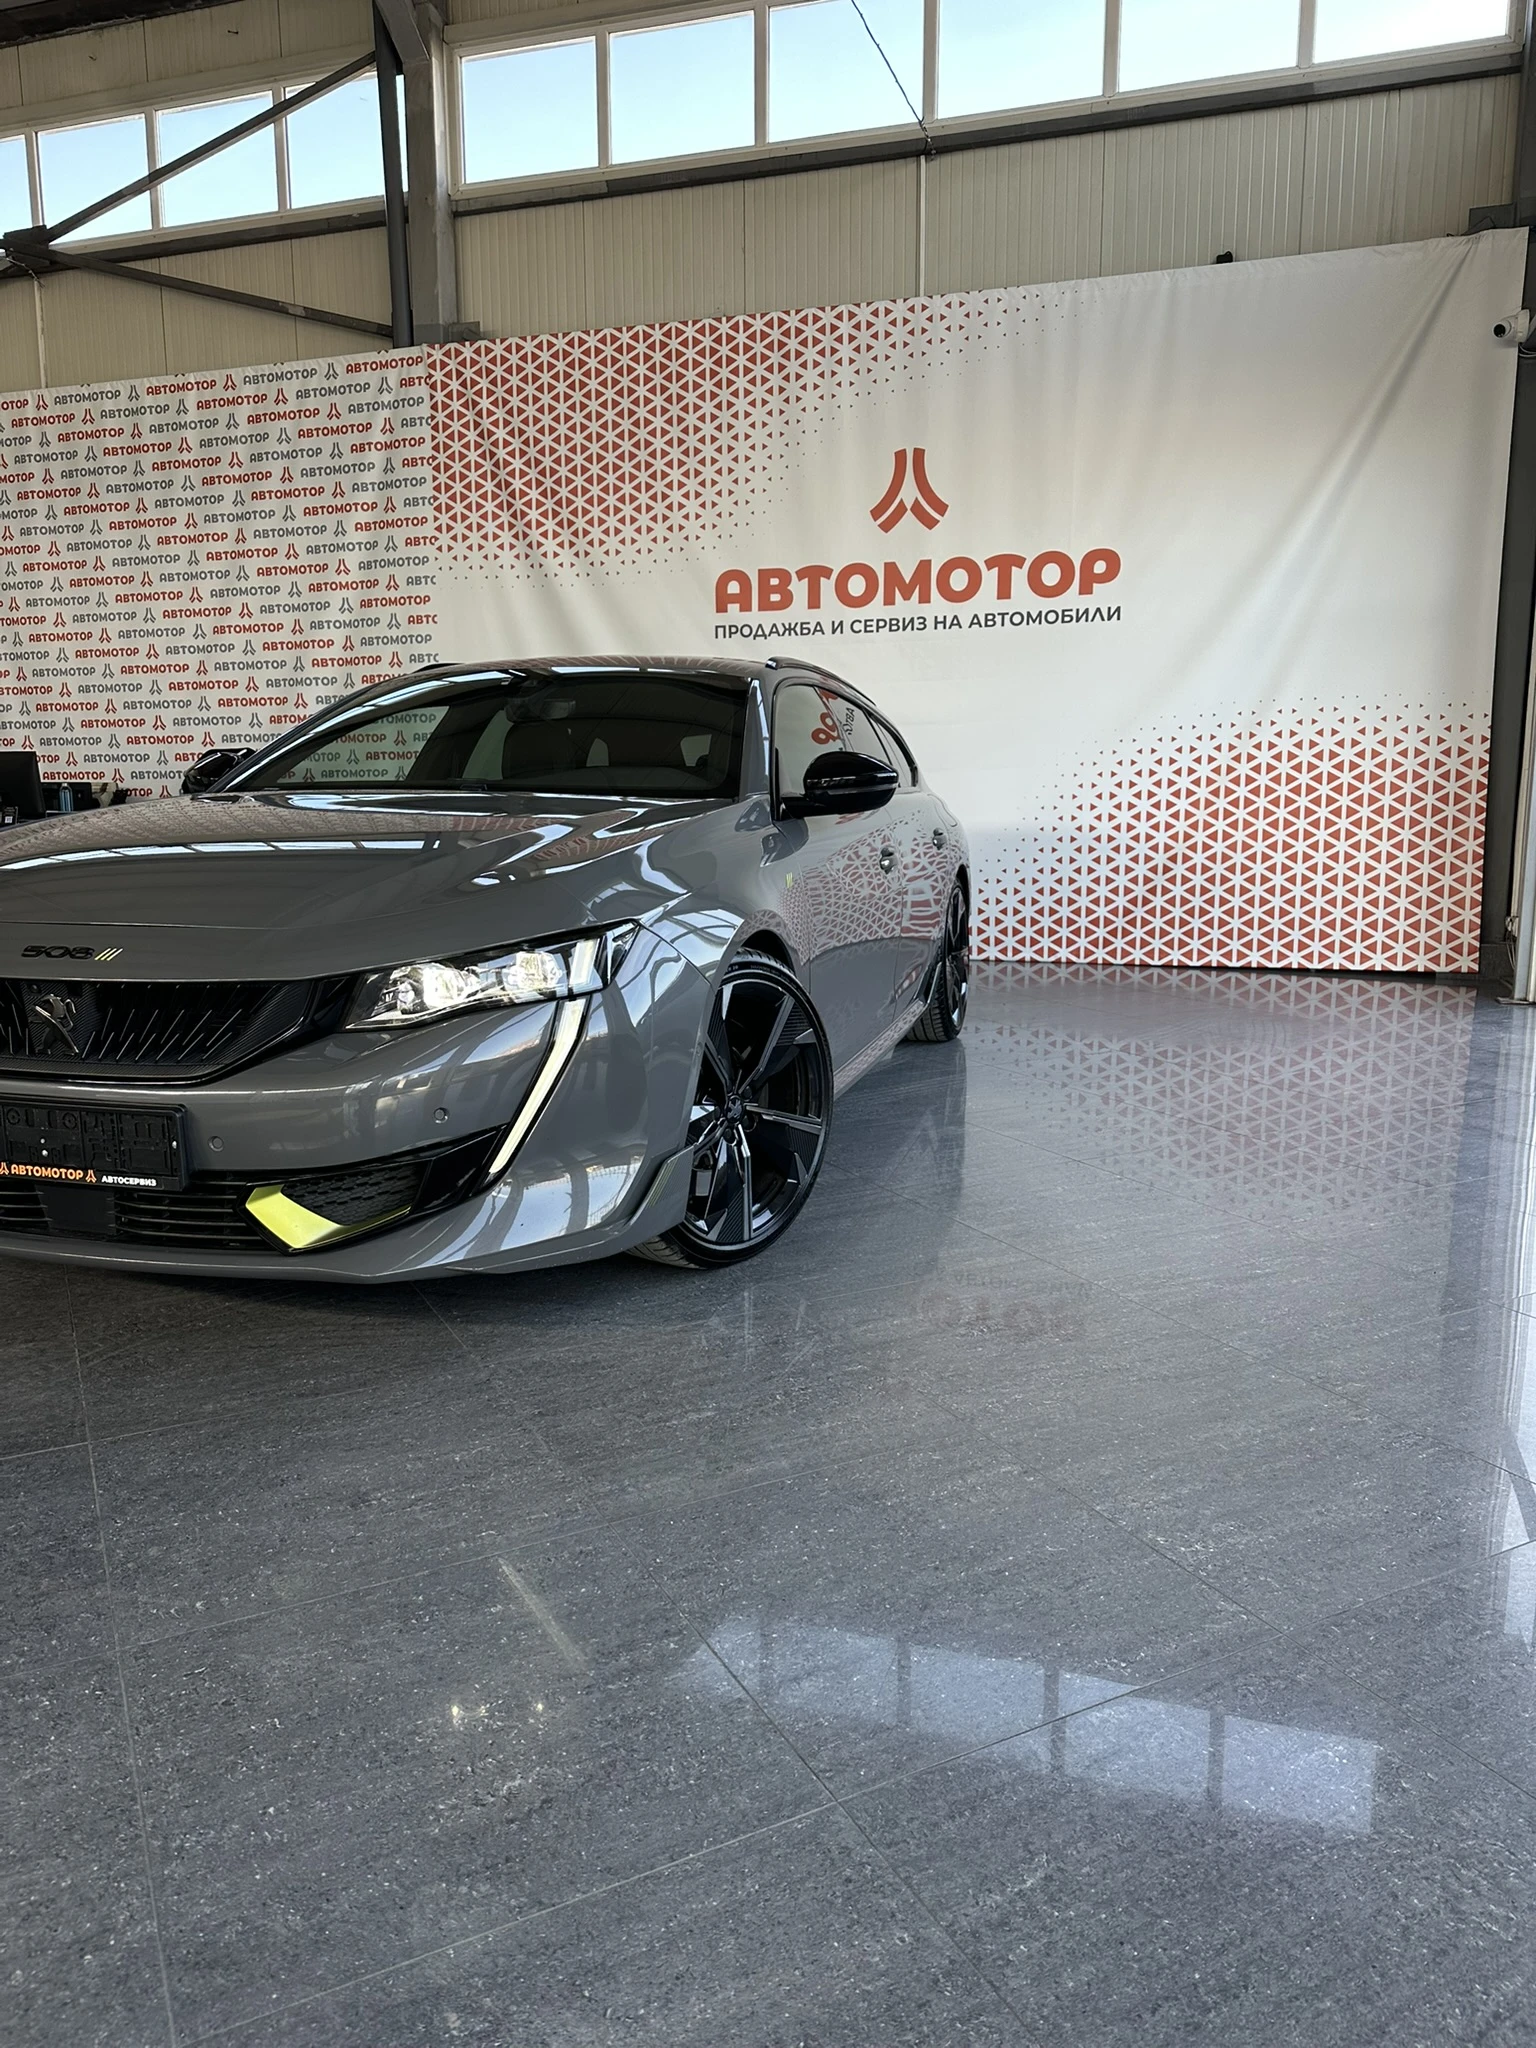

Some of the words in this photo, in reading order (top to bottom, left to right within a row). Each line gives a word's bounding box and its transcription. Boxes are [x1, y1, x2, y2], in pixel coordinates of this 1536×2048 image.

[54, 390, 121, 405] АВТОМОТОР
[146, 380, 216, 396] АВТОМОТОР
[244, 368, 317, 385] АВТОМОТОР
[346, 356, 423, 374] АВТОМОТОР
[12, 413, 75, 428] АВТОМОТОР
[100, 404, 170, 419] АВТОМОТОР
[197, 394, 267, 410] АВТОМОТОР
[296, 382, 370, 400] АВТОМОТОР
[58, 428, 124, 442] АВТОМОТОР
[150, 418, 219, 434] АВТОМОТОР
[247, 408, 320, 424] АВТОМОТОР
[348, 396, 424, 414] АВТОМОТОР
[14, 450, 78, 464] АВТОМОТОР
[103, 442, 172, 456] АВТОМОТОР
[200, 432, 269, 448] АВТОМОТОР
[298, 422, 372, 439] АВТОМОТОР
[61, 465, 127, 479] АВТОМОТОР
[152, 456, 221, 472] АВТОМОТОР
[250, 447, 322, 463] АВТОМОТОР
[350, 437, 425, 454] АВТОМОТОР
[17, 487, 81, 501] АВТОМОТОР
[106, 479, 174, 494] АВТОМОТОР
[202, 471, 272, 486] АВТОМОТОР
[300, 462, 375, 478] АВТОМОТОР
[0, 508, 38, 520] МОТОР
[64, 502, 130, 516] АВТОМОТОР
[155, 494, 224, 508] АВТОМОТОР
[251, 486, 325, 501] АВТОМОТОР
[352, 476, 426, 492] АВТОМОТОР
[20, 524, 84, 536] АВТОМОТОР
[109, 517, 177, 530] АВТОМОТОР
[204, 510, 276, 524] АВТОМОТОР
[304, 502, 378, 516] АВТОМОТОР
[67, 539, 132, 552] АВТОМОТОР
[157, 532, 228, 546] АВТОМОТОР
[254, 525, 327, 539] АВТОМОТОР
[355, 516, 428, 532] АВТОМОТОР
[23, 560, 87, 572] АВТОМОТОР
[112, 554, 180, 567] АВТОМОТОР
[206, 548, 278, 561] АВТОМОТОР
[306, 540, 378, 555] АВТОМОТОР
[70, 575, 134, 588] АВТОМОТОР
[160, 570, 230, 582] АВТОМОТОР
[257, 563, 328, 577] АВТОМОТОР
[358, 556, 429, 571] АВТОМОТОР
[715, 548, 1122, 614] АВТОМОТОР
[26, 596, 90, 608] АВТОМОТОР
[115, 591, 183, 603] АВТОМОТОР
[210, 585, 280, 598] АВТОМОТОР
[308, 579, 379, 592] АВТОМОТОР
[72, 611, 137, 623] АВТОМОТОР
[163, 606, 232, 619] АВТОМОТОР
[260, 601, 330, 614] АВТОМОТОР
[360, 595, 431, 609] АВТОМОТОР
[714, 621, 825, 640] ПРОДАЖБА
[832, 620, 844, 634] И
[850, 616, 927, 634] СЕРВИЗ
[934, 614, 962, 630] НА
[968, 606, 1122, 628] АВТОМОБИЛИ
[29, 632, 93, 642] АВТОМОТОР
[118, 627, 185, 639] АВТОМОТОР
[213, 623, 284, 635] АВТОМОТОР
[310, 617, 380, 630] АВТОМОТОР
[0, 651, 50, 661] ТОМОТОР
[75, 647, 139, 658] АВТОМОТОР
[166, 643, 235, 655] АВТОМОТОР
[262, 639, 334, 651] АВТОМОТОР
[360, 634, 432, 646] АВТОМОТОР
[32, 667, 96, 677] АВТОМОТОР
[121, 664, 189, 674] АВТОМОТОР
[214, 660, 287, 671] АВТОМОТОР
[312, 655, 382, 668] АВТОМОТОР
[78, 683, 142, 694] АВТОМОТОР
[168, 680, 238, 691] АВТОМОТОР
[266, 676, 338, 688] АВТОМОТОР
[36, 702, 98, 712] АВТОМОТОР
[123, 700, 192, 710] АВТОМОТОР
[218, 696, 288, 707] АВТОМОТОР
[0, 720, 56, 730] ВТОМОТОР
[81, 718, 146, 728] АВТОМОТОР
[173, 716, 241, 726] АВТОМОТОР
[40, 737, 102, 746] АВТОМОТОР
[127, 735, 194, 745] АВТОМОТОР
[84, 754, 150, 763] АВТОМОТОР
[42, 771, 105, 780] АВТОМОТОР
[321, 769, 388, 779] АВТОМОТОР
[22, 945, 94, 960] 508
[10, 1164, 84, 1180] АВТОМОТОР
[102, 1175, 157, 1186] АВТОСЕРВИЗ
